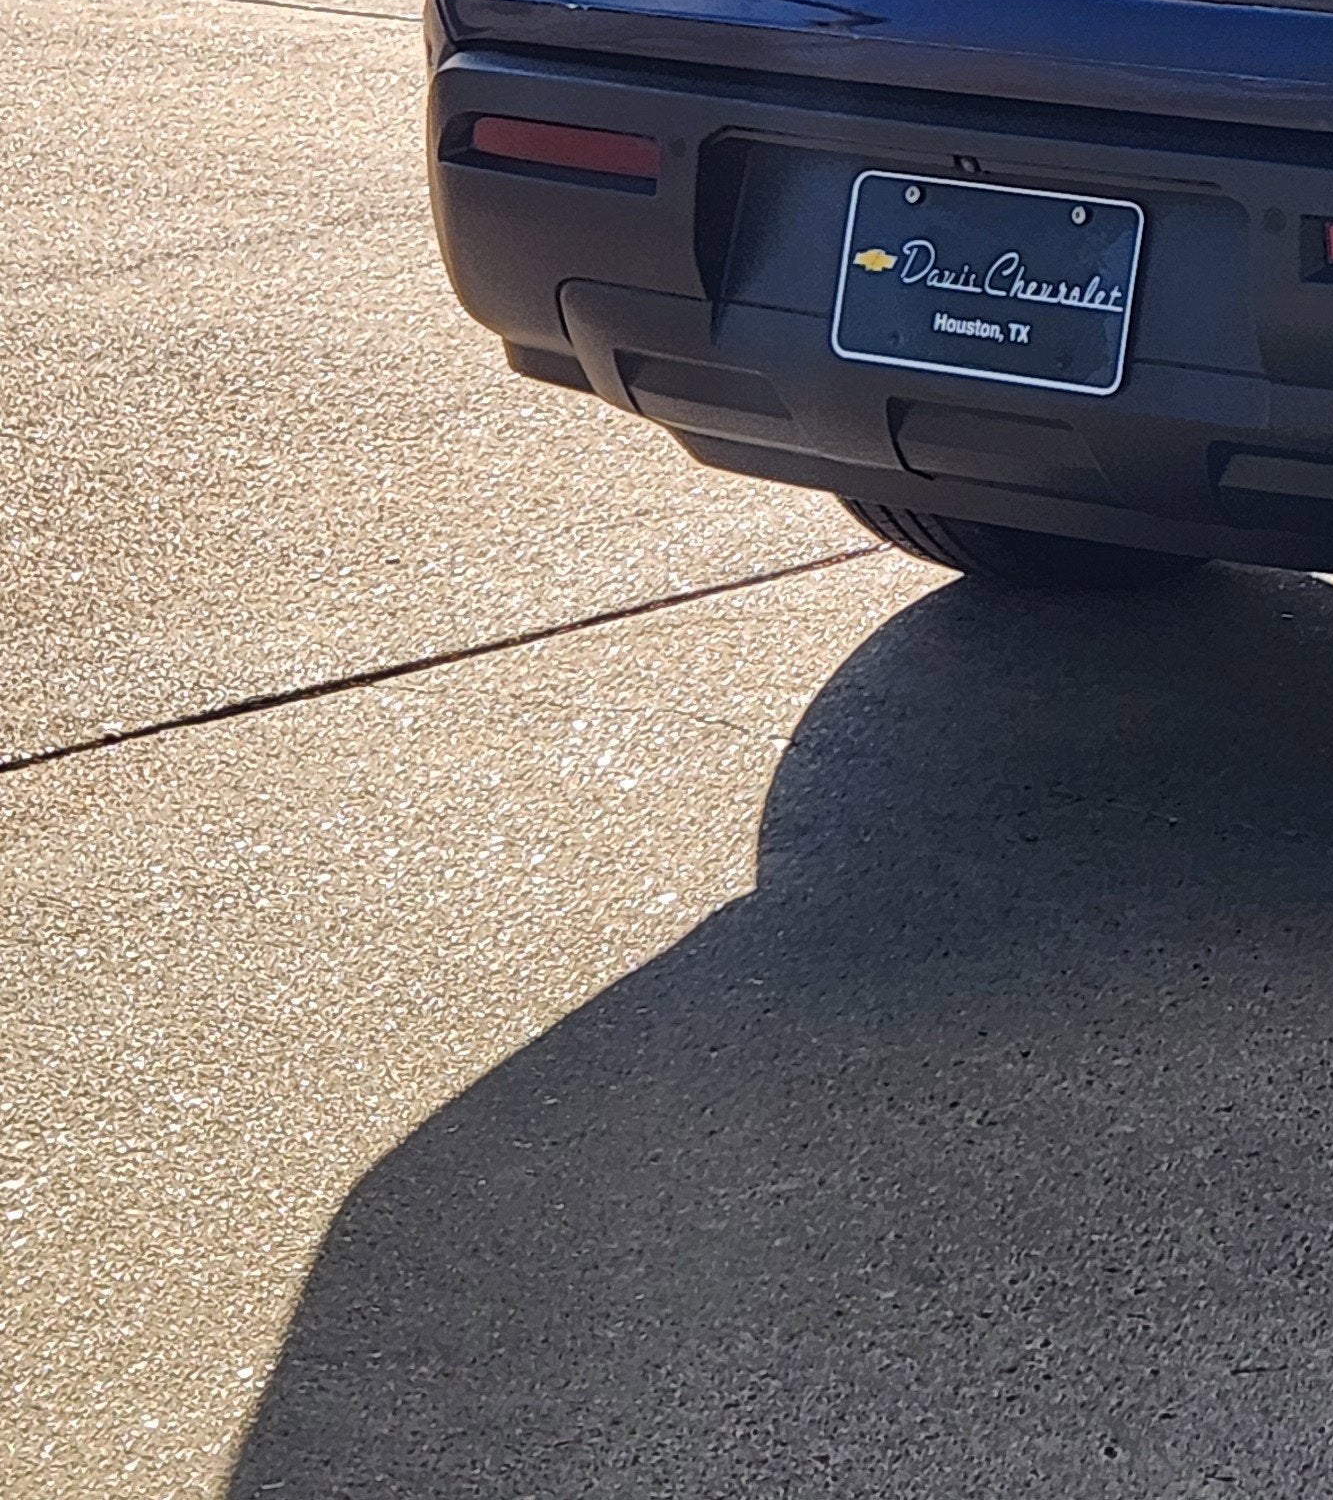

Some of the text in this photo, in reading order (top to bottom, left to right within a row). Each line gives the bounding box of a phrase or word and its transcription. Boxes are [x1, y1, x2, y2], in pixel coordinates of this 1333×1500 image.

[901, 240, 1123, 312] Davis Chevrolet
[933, 312, 1031, 344] Houston, TX
